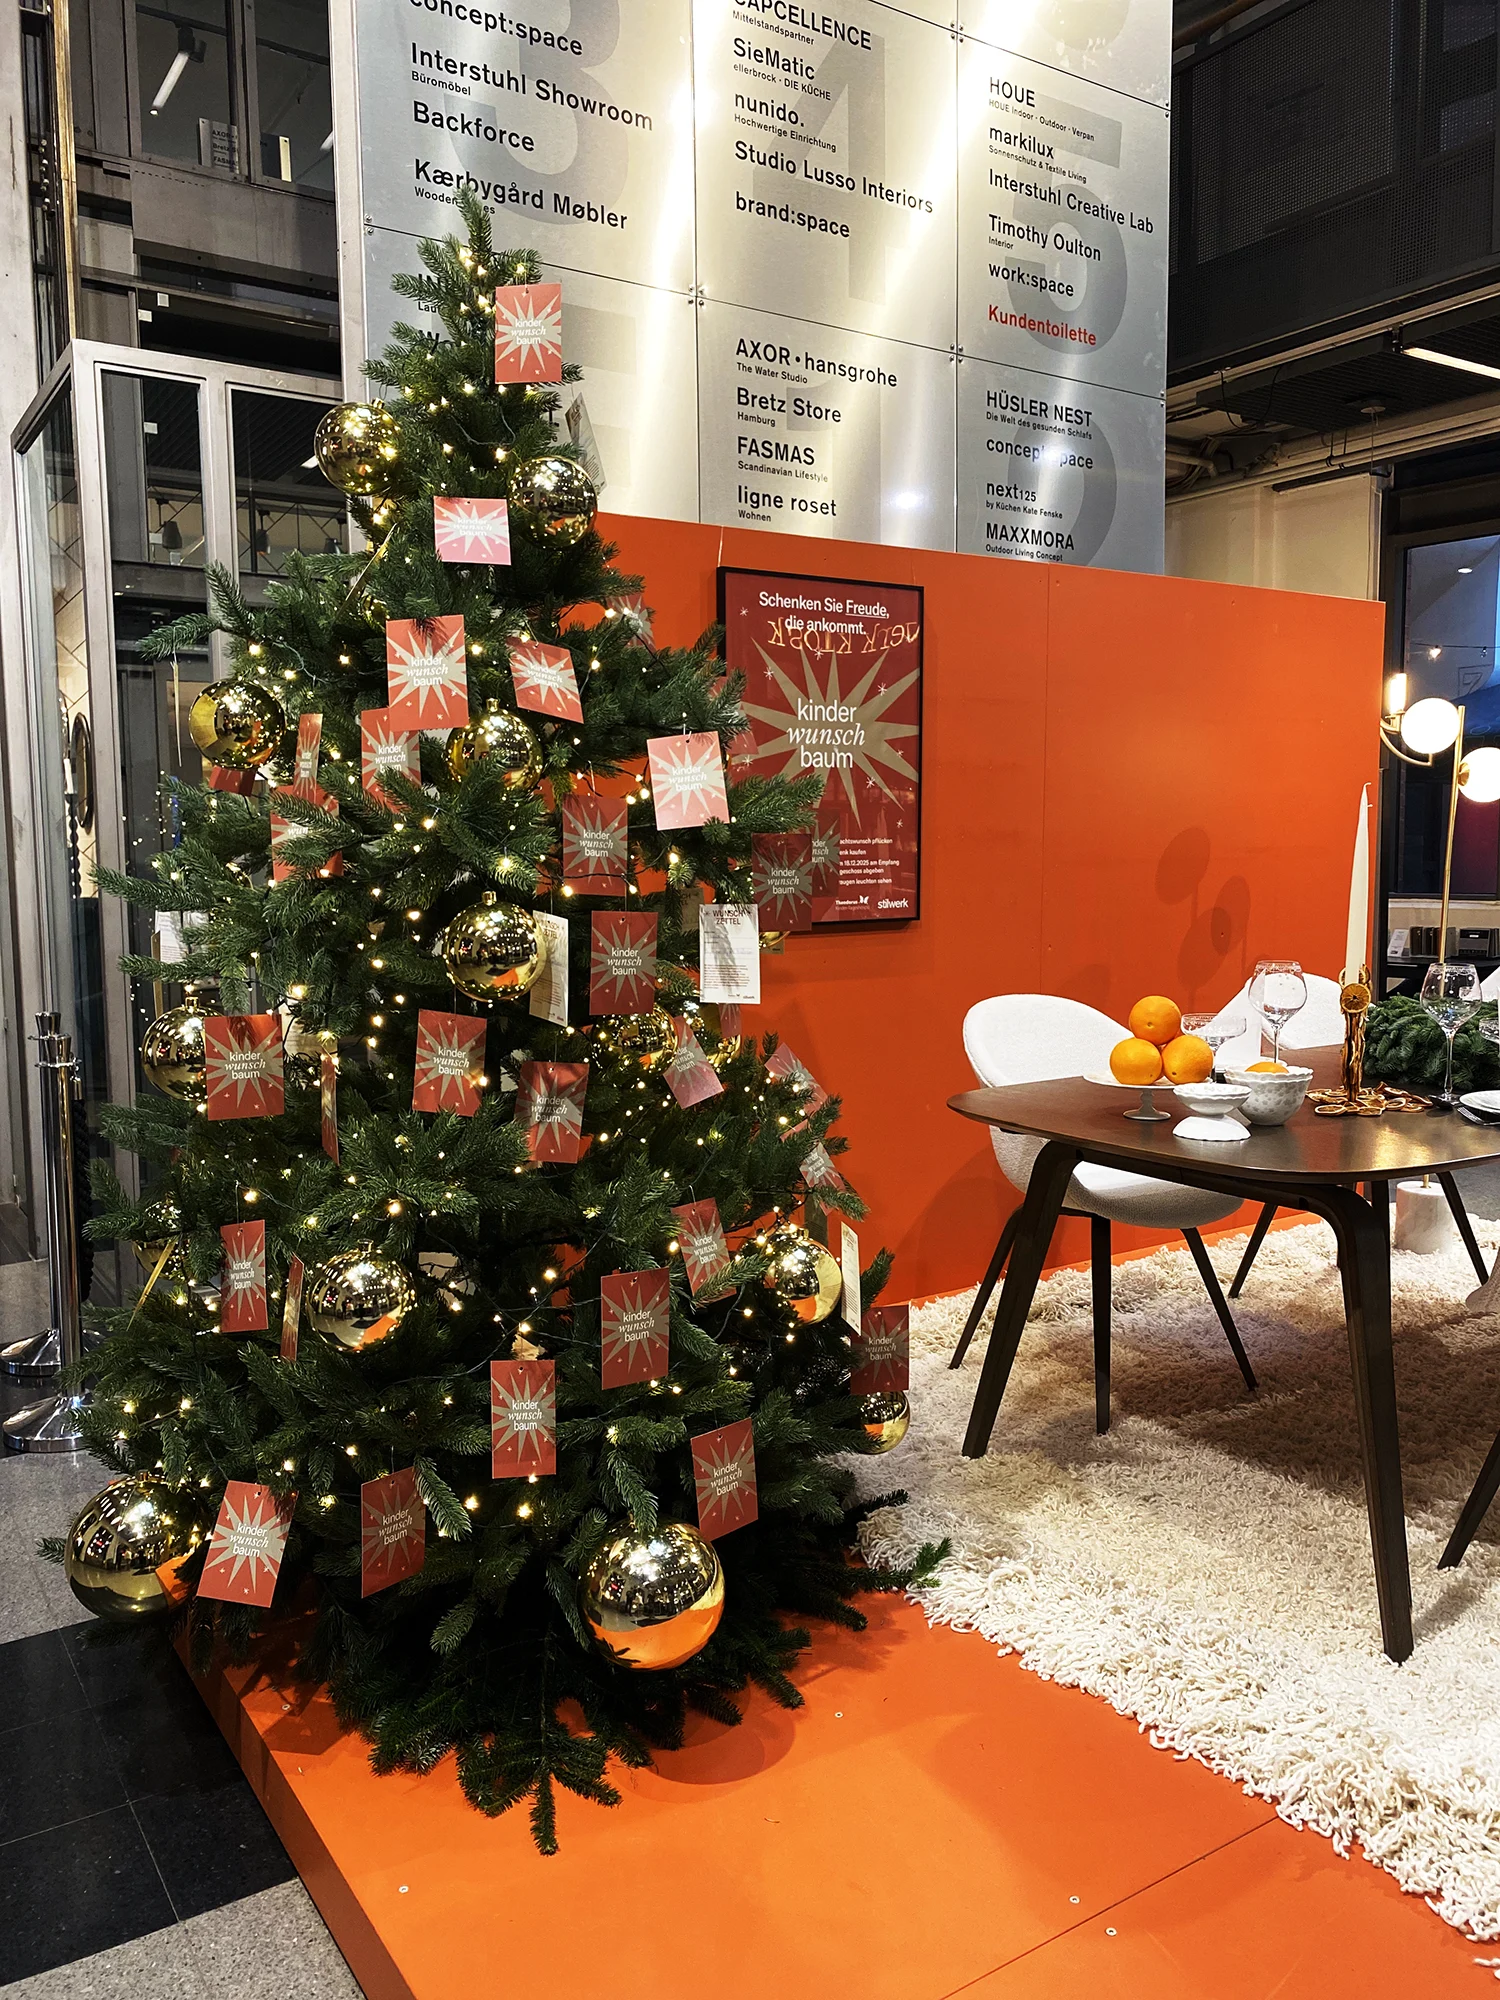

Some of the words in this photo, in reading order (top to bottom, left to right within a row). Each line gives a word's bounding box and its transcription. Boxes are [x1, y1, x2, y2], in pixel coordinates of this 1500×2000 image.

[733, 11, 814, 45] Mittelstandspartner
[733, 38, 815, 80] SieMatic
[412, 71, 471, 95] Büromöbel
[412, 42, 526, 95] Interstuhl
[535, 79, 653, 131] Showroom
[733, 63, 776, 82] ellerbrock
[784, 78, 799, 90] DIE
[801, 84, 831, 100] KÜCHE
[990, 76, 1035, 108] HOUE
[735, 92, 805, 127] nunido.
[413, 101, 535, 151] Backforce
[734, 113, 787, 137] Hochwertige
[790, 130, 836, 152] Einrichtung
[1040, 116, 1067, 132] Outdoor
[1072, 127, 1095, 142] Verpan
[990, 127, 1054, 159] markilux
[989, 145, 1037, 168] Sonnenschutz
[1045, 162, 1066, 177] Textile
[1068, 169, 1087, 184] Living
[735, 140, 796, 174] Studio
[803, 160, 855, 191] Lusso
[863, 177, 933, 213] Interiors
[415, 159, 544, 209] Kærbygård
[553, 193, 628, 229] Møbler
[989, 168, 1061, 206] Interstuhl
[1067, 193, 1125, 225] Creative
[1130, 212, 1154, 234] Lab
[736, 191, 850, 238] brand:space
[988, 236, 1014, 250] Interior
[989, 214, 1048, 249] Timothy
[1054, 233, 1101, 261] Oulton
[989, 262, 1074, 297] work:space
[515, 318, 542, 327] kinder
[989, 304, 1096, 346] Kundentoilette
[511, 326, 546, 336] wunsch
[516, 335, 541, 345] baum
[737, 362, 752, 373] The
[755, 366, 779, 378] Water
[781, 371, 808, 384] Studio
[737, 387, 786, 413] Bretz
[793, 398, 842, 423] Store
[987, 390, 1048, 418] HÜSLER
[1054, 405, 1092, 427] NEST
[737, 412, 776, 427] Hamburg
[986, 411, 998, 422] Die
[1000, 414, 1016, 425] Welt
[1018, 418, 1030, 428] des
[1032, 421, 1065, 435] gesunden
[1067, 427, 1092, 440] Schlafs
[738, 436, 815, 466] FASMAS
[986, 439, 1093, 469] conceppace
[738, 460, 793, 477] Scandinavian
[795, 470, 828, 483] Lifestyle
[738, 485, 783, 509] ligne
[791, 497, 836, 516] roset
[738, 510, 771, 522] Wohnen
[986, 500, 994, 510] by
[996, 502, 1021, 513] Küchen
[1023, 506, 1038, 515] Kate
[1040, 509, 1063, 519] Fenske
[986, 522, 1074, 550] MAXXMORA
[986, 544, 1013, 555] Outdoor
[1015, 548, 1034, 559] Living
[1036, 551, 1063, 562] Concept
[759, 591, 821, 611] Schenken
[824, 597, 843, 612] Sie
[845, 600, 890, 619] Freude,
[785, 615, 804, 630] die
[807, 618, 867, 635] ankommt.
[411, 655, 442, 667] kinder
[406, 664, 448, 677] wunsch
[413, 676, 442, 686] baum
[797, 698, 857, 722] kinder
[787, 723, 865, 746] wunsch
[378, 744, 403, 754] kinder
[375, 753, 406, 764] wunsch
[800, 745, 853, 768] baum
[672, 764, 702, 775] kinder
[668, 772, 707, 784] wunsch
[675, 781, 703, 791] baum
[583, 829, 610, 841] kinder
[579, 839, 614, 849] wunsch
[584, 848, 609, 858] baum
[771, 868, 795, 877] kinder
[767, 876, 800, 885] wunsch
[772, 886, 794, 894] baum
[611, 948, 639, 958] kinder
[607, 956, 642, 967] wunsch
[612, 966, 637, 976] baum
[229, 1050, 261, 1063] kinder
[438, 1046, 466, 1058] kinder
[224, 1060, 266, 1072] wunsch
[432, 1055, 470, 1068] wunsch
[231, 1069, 260, 1080] baum
[438, 1065, 464, 1077] baum
[536, 1094, 565, 1106] kinder
[531, 1103, 568, 1115] wunsch
[535, 1112, 561, 1123] baum
[694, 1235, 713, 1247] kinder
[693, 1243, 718, 1255] wunsch
[699, 1251, 717, 1264] baum
[232, 1260, 252, 1271] kinder
[230, 1269, 255, 1280] wunsch
[233, 1279, 252, 1289] baum
[623, 1309, 651, 1322] kinder
[617, 1317, 655, 1333] wunsch
[624, 1329, 649, 1342] baum
[868, 1336, 893, 1345] kinder
[864, 1343, 897, 1353] wunsch
[870, 1351, 892, 1361] baum
[512, 1400, 539, 1410] kinder
[508, 1409, 543, 1421] wunsch
[514, 1420, 538, 1431] baum
[712, 1461, 739, 1475] kinder
[710, 1468, 743, 1488] wunsch
[716, 1481, 738, 1496] baum
[382, 1507, 409, 1524] kinder
[236, 1523, 268, 1538] kinder
[378, 1515, 414, 1538] wunsch
[229, 1533, 269, 1548] wunsch
[383, 1528, 408, 1545] baum
[232, 1544, 260, 1558] baum
